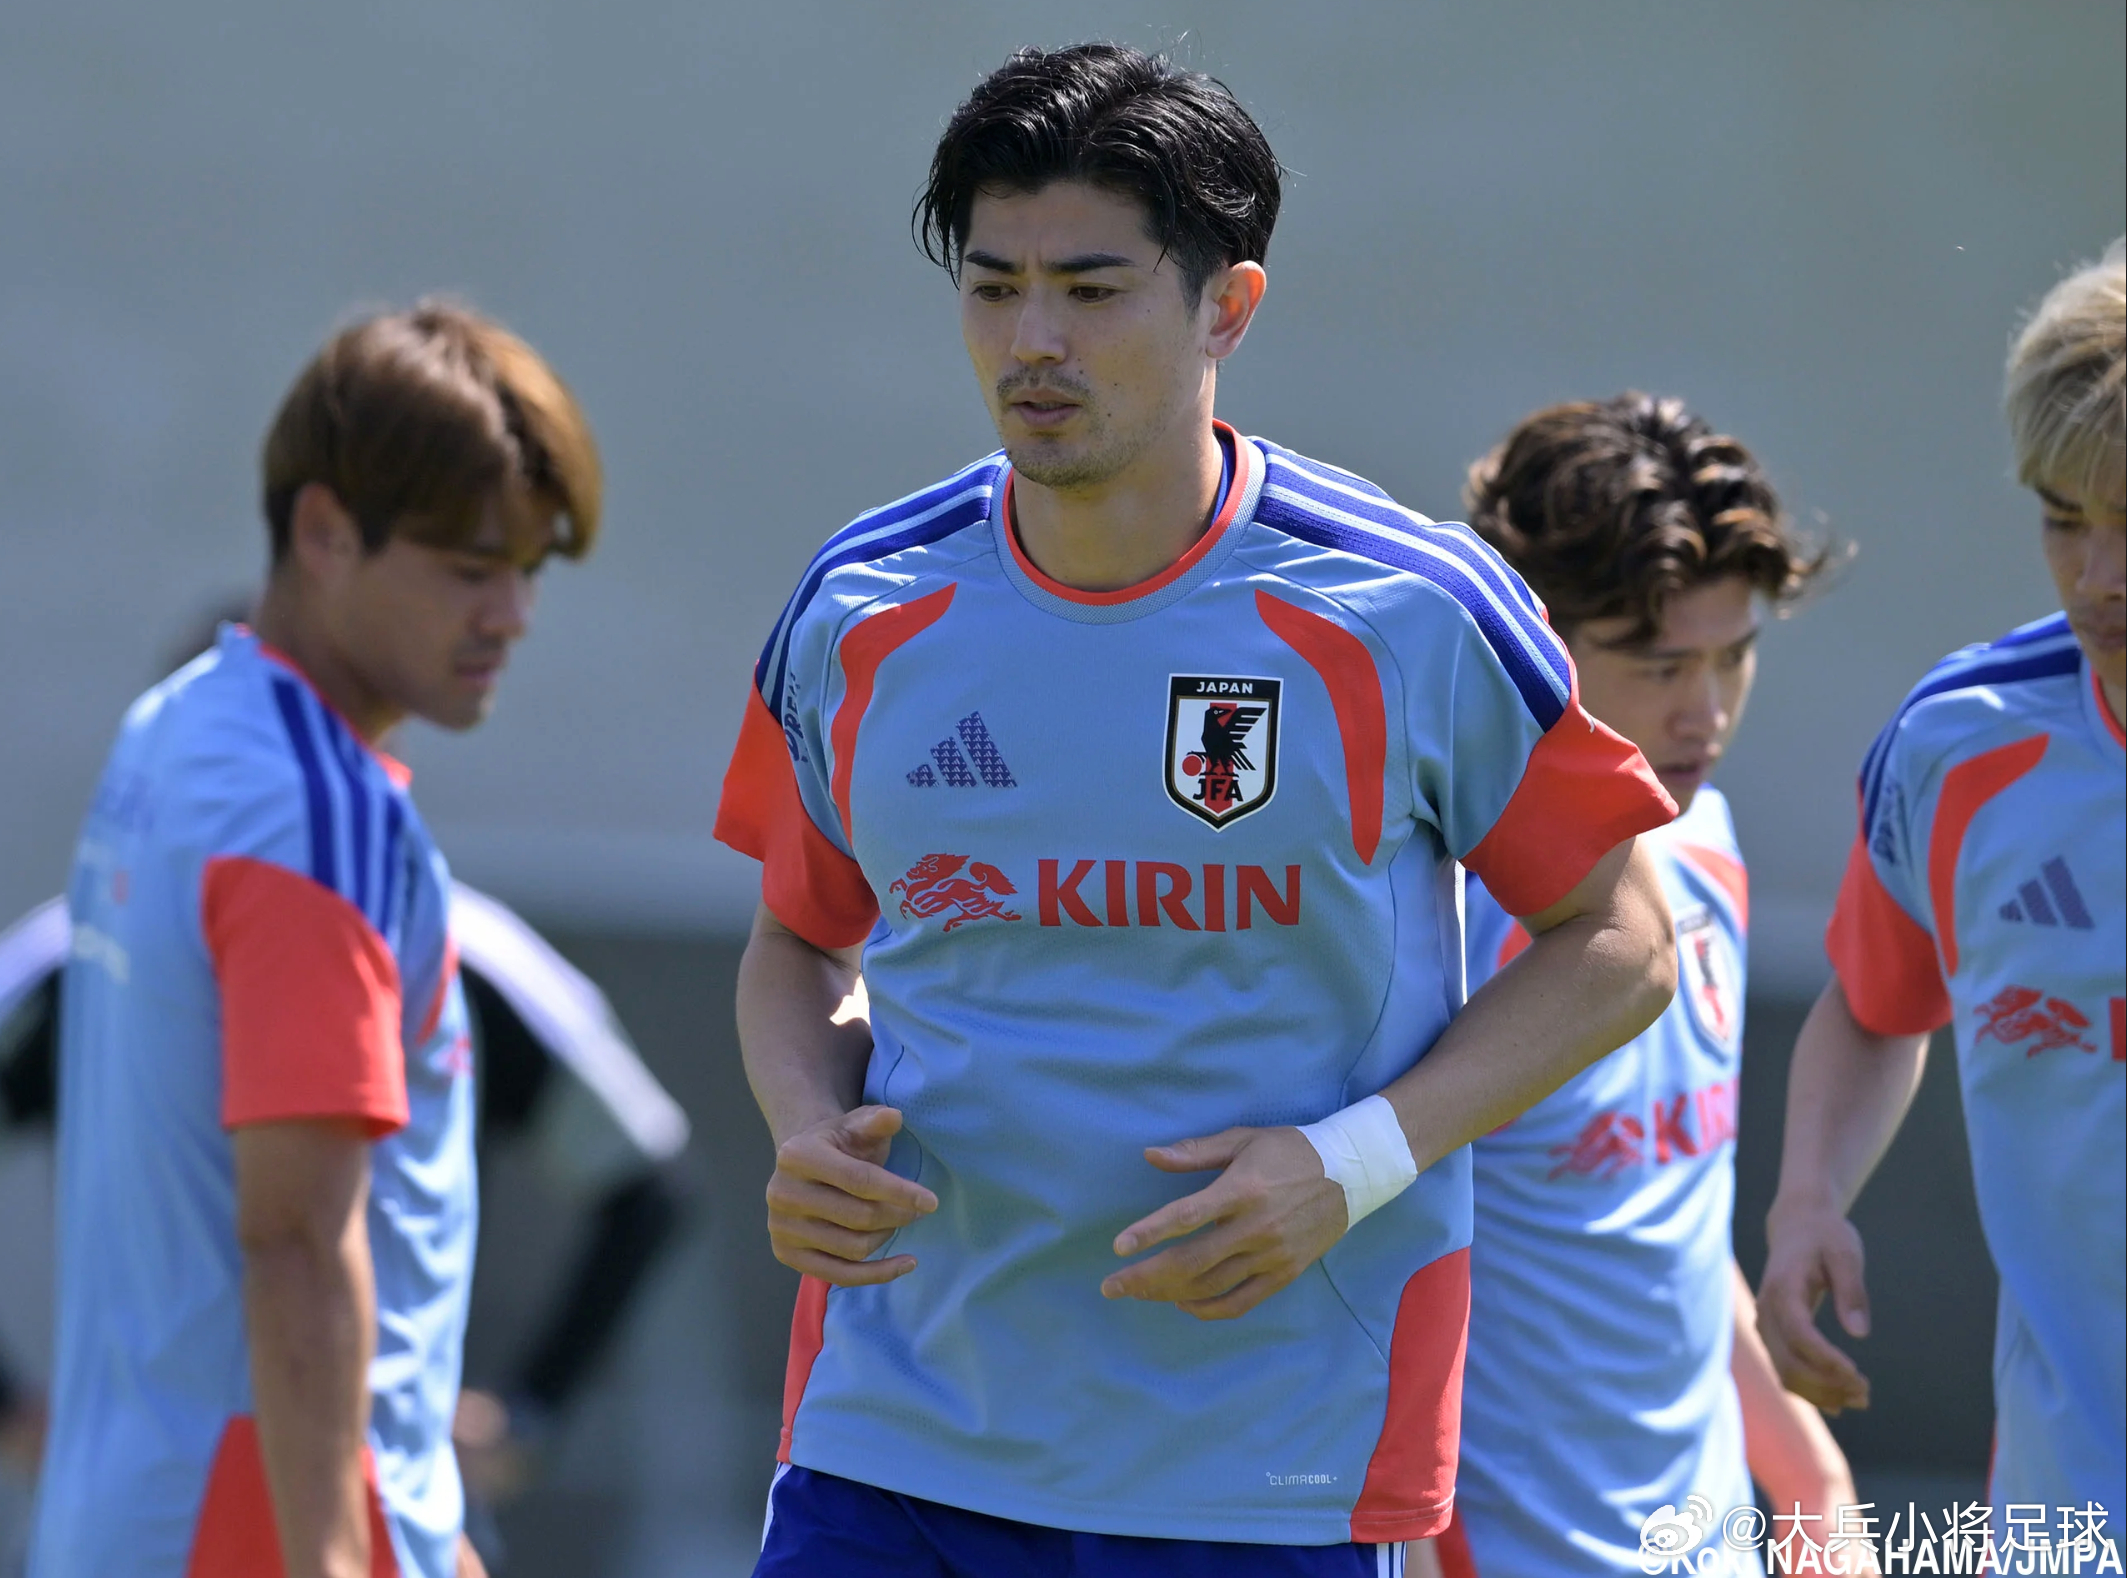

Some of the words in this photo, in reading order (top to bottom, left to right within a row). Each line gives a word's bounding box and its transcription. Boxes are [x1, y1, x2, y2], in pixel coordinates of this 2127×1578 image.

[1196, 681, 1253, 694] JAPAN
[1192, 778, 1244, 802] JFA
[1037, 858, 1301, 932] KIRIN
